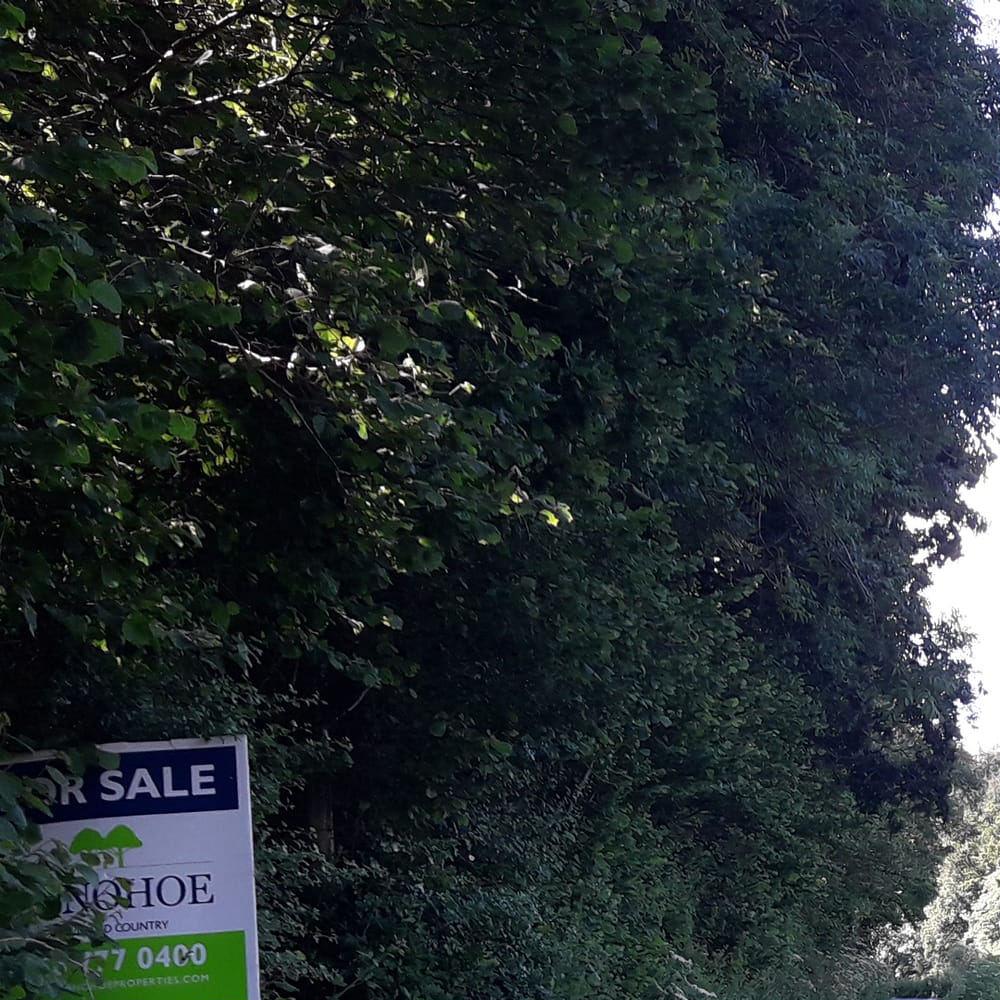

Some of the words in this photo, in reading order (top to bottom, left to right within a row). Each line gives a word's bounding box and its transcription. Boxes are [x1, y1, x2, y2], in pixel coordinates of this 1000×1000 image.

[100, 764, 216, 802] SALE
[115, 920, 169, 933] COUNTRY
[137, 942, 207, 970] 0400
[106, 974, 209, 991] PROPERTIES.COM
